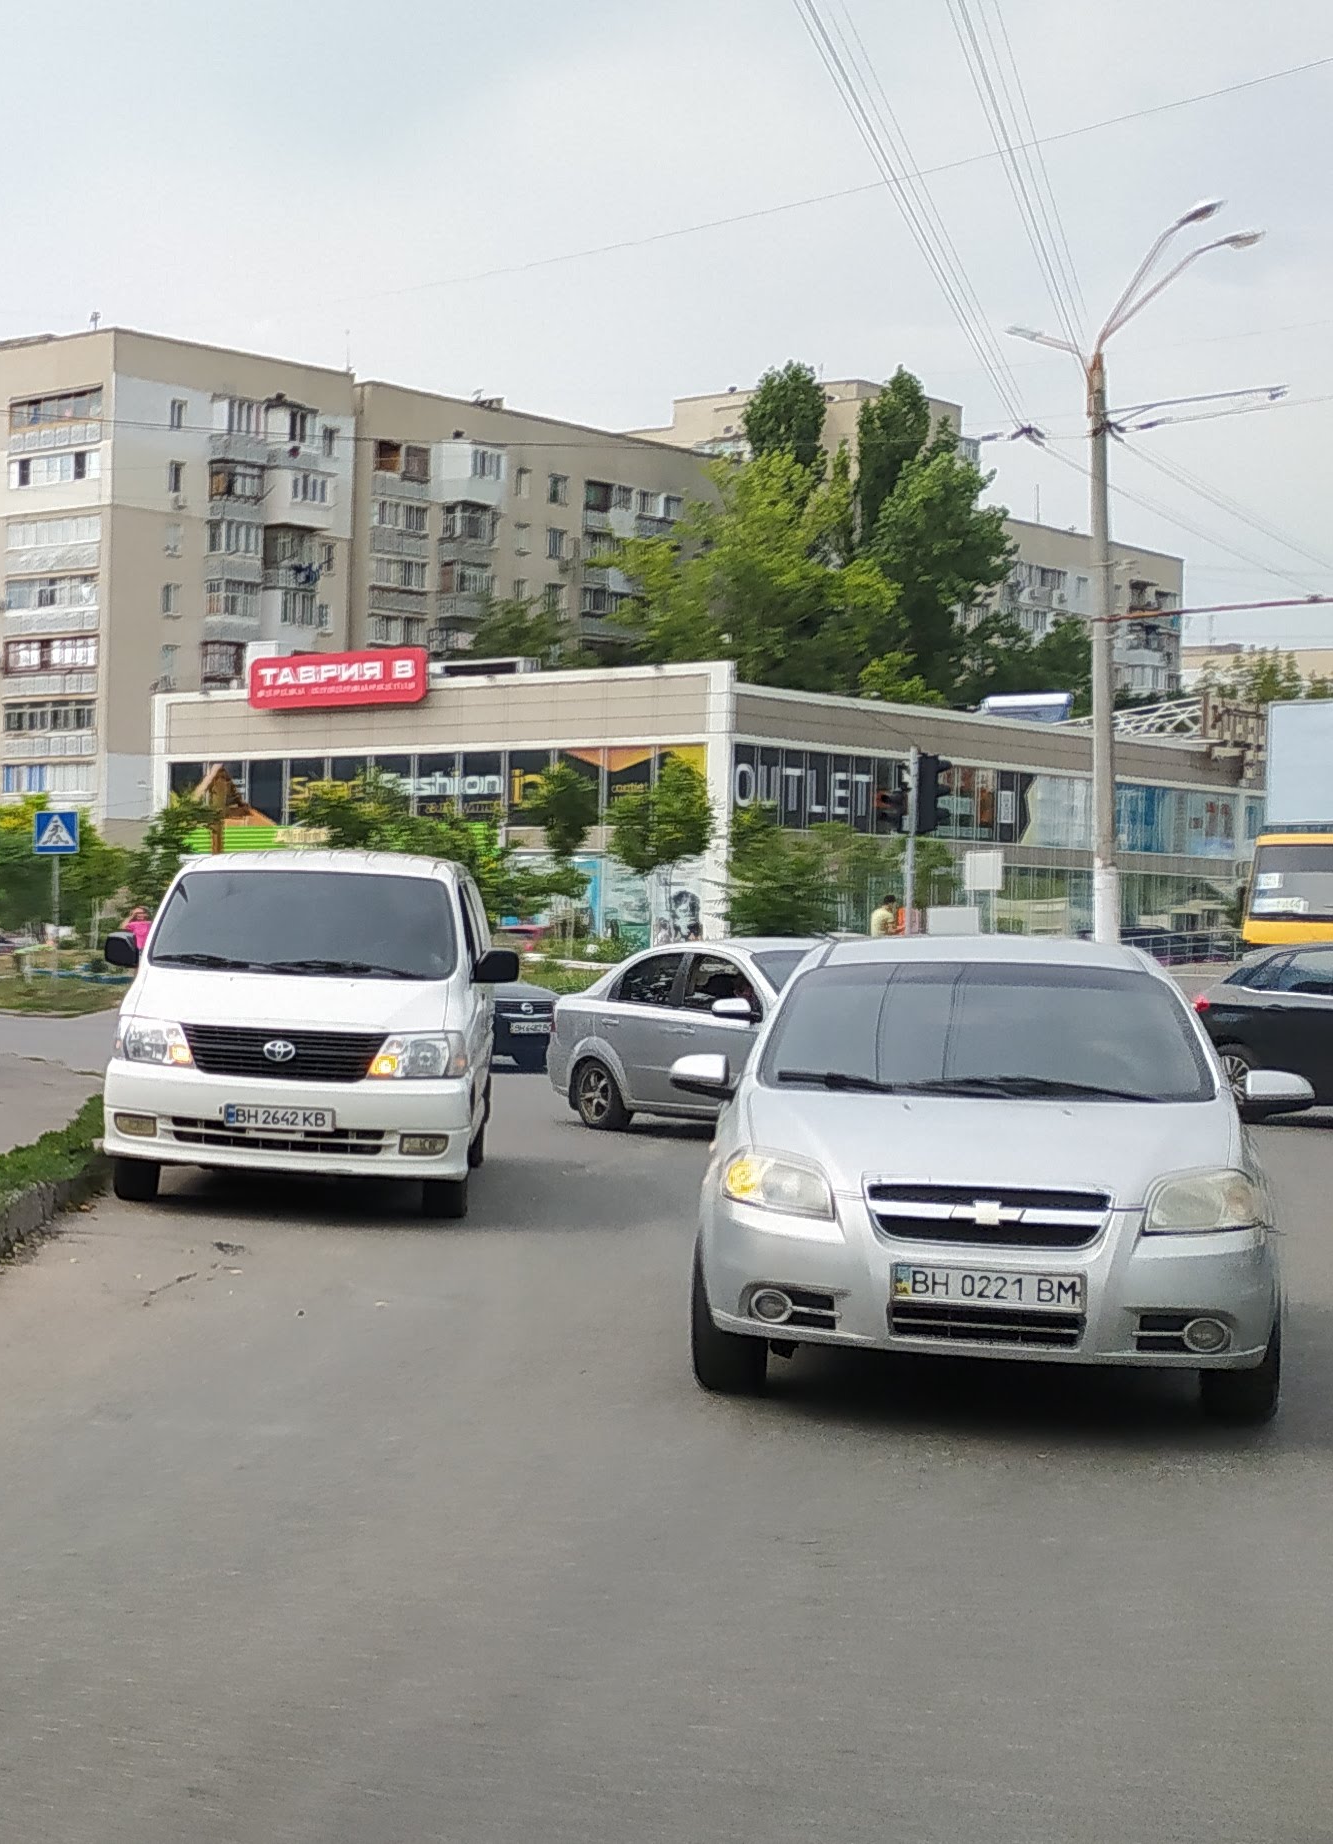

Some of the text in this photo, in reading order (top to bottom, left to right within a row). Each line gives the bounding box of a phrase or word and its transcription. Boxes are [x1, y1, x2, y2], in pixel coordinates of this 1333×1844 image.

[259, 660, 415, 686] ТАВРИЯ В
[735, 763, 874, 817] OUTLET
[235, 1108, 326, 1127] BH 2642 KB
[911, 1270, 949, 1296] BH
[961, 1274, 1023, 1302] 0221
[1037, 1278, 1077, 1305] BM
